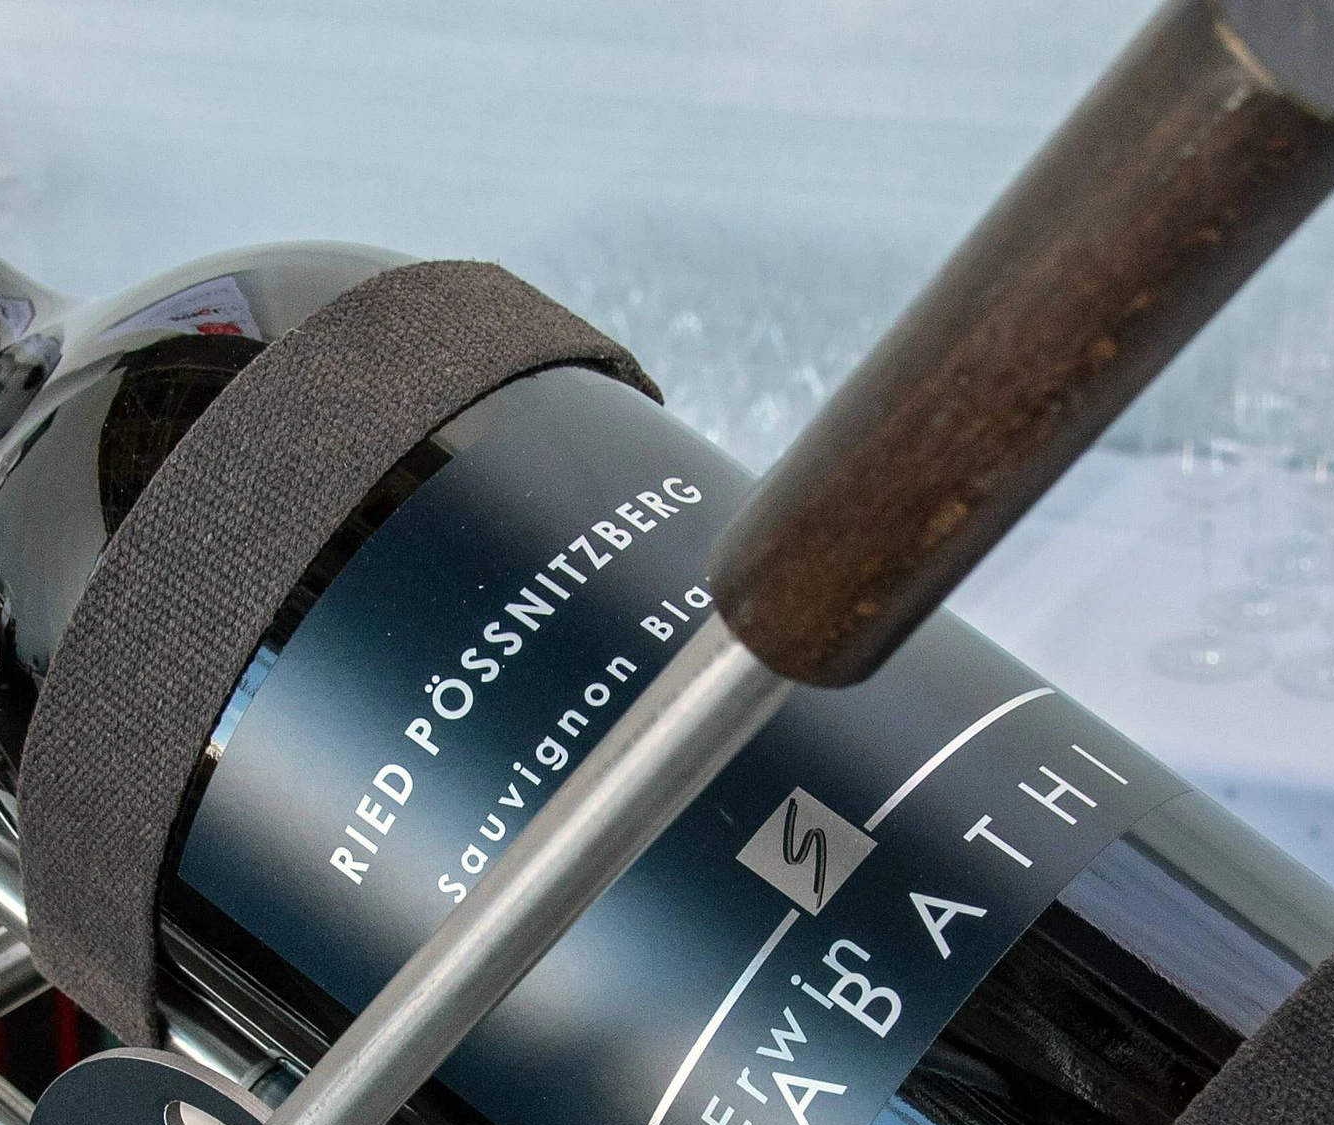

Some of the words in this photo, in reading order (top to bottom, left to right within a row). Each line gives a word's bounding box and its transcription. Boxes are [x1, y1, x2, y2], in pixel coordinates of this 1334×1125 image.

[329, 763, 415, 886] RIED
[404, 475, 704, 757] PÖSSNITZBERG
[437, 655, 639, 904] Sauvignon
[640, 576, 714, 642] Bla
